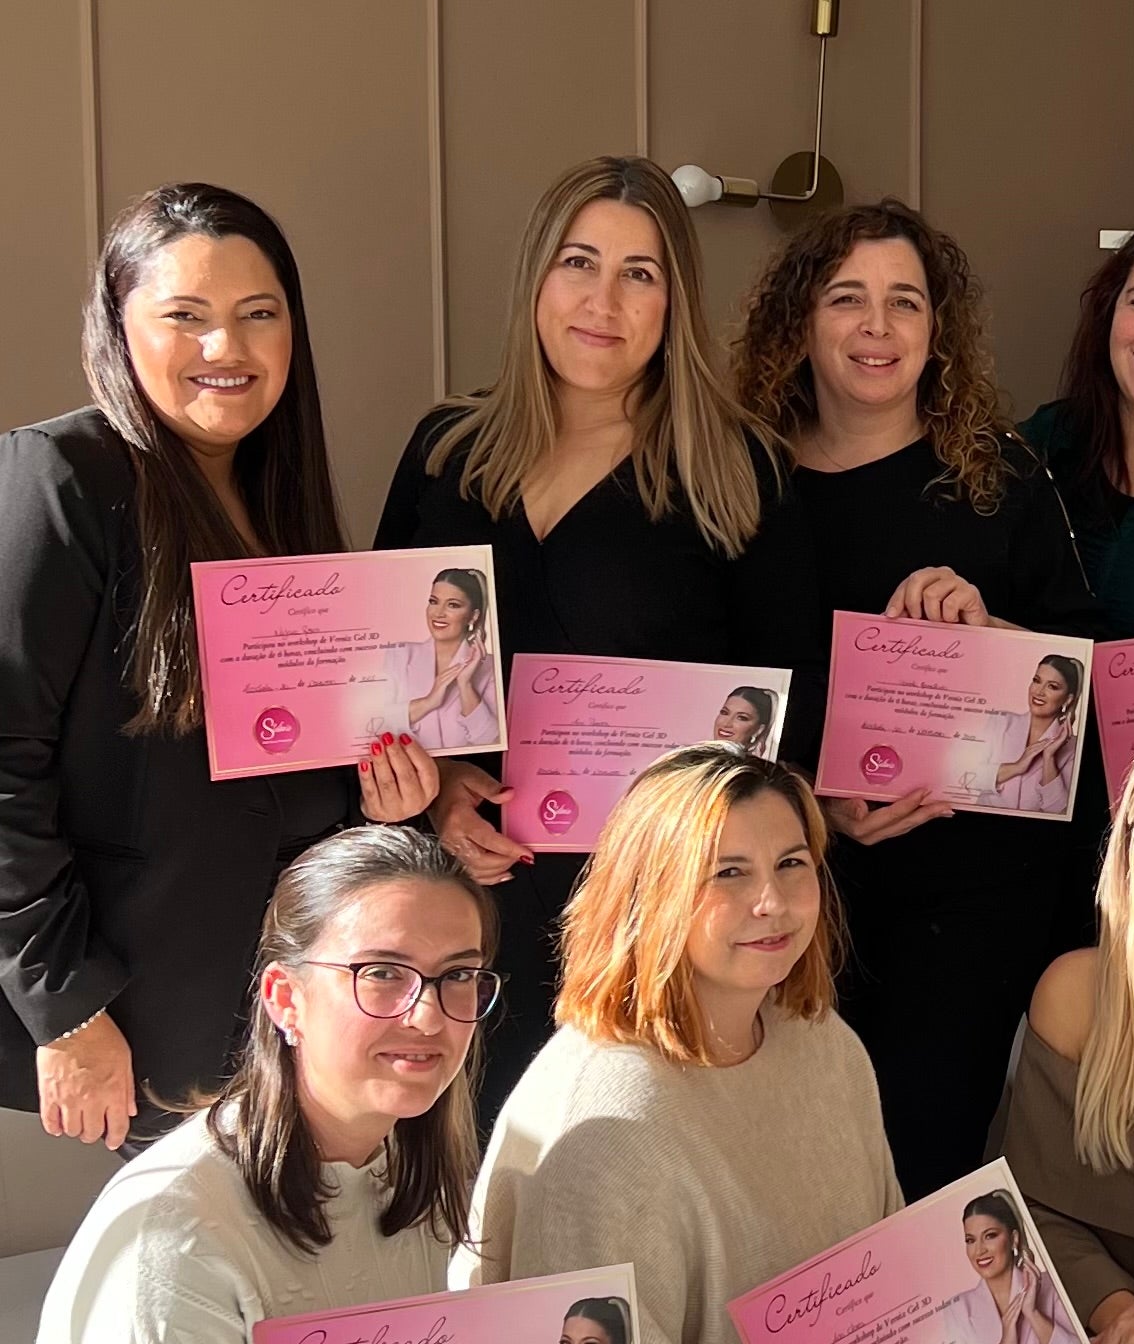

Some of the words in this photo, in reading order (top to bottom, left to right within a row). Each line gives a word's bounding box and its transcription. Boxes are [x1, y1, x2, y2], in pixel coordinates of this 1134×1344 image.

[220, 572, 346, 615] Certificado
[855, 625, 965, 664] Certificado
[532, 667, 646, 705] Certificado
[765, 1250, 882, 1334] Certificado
